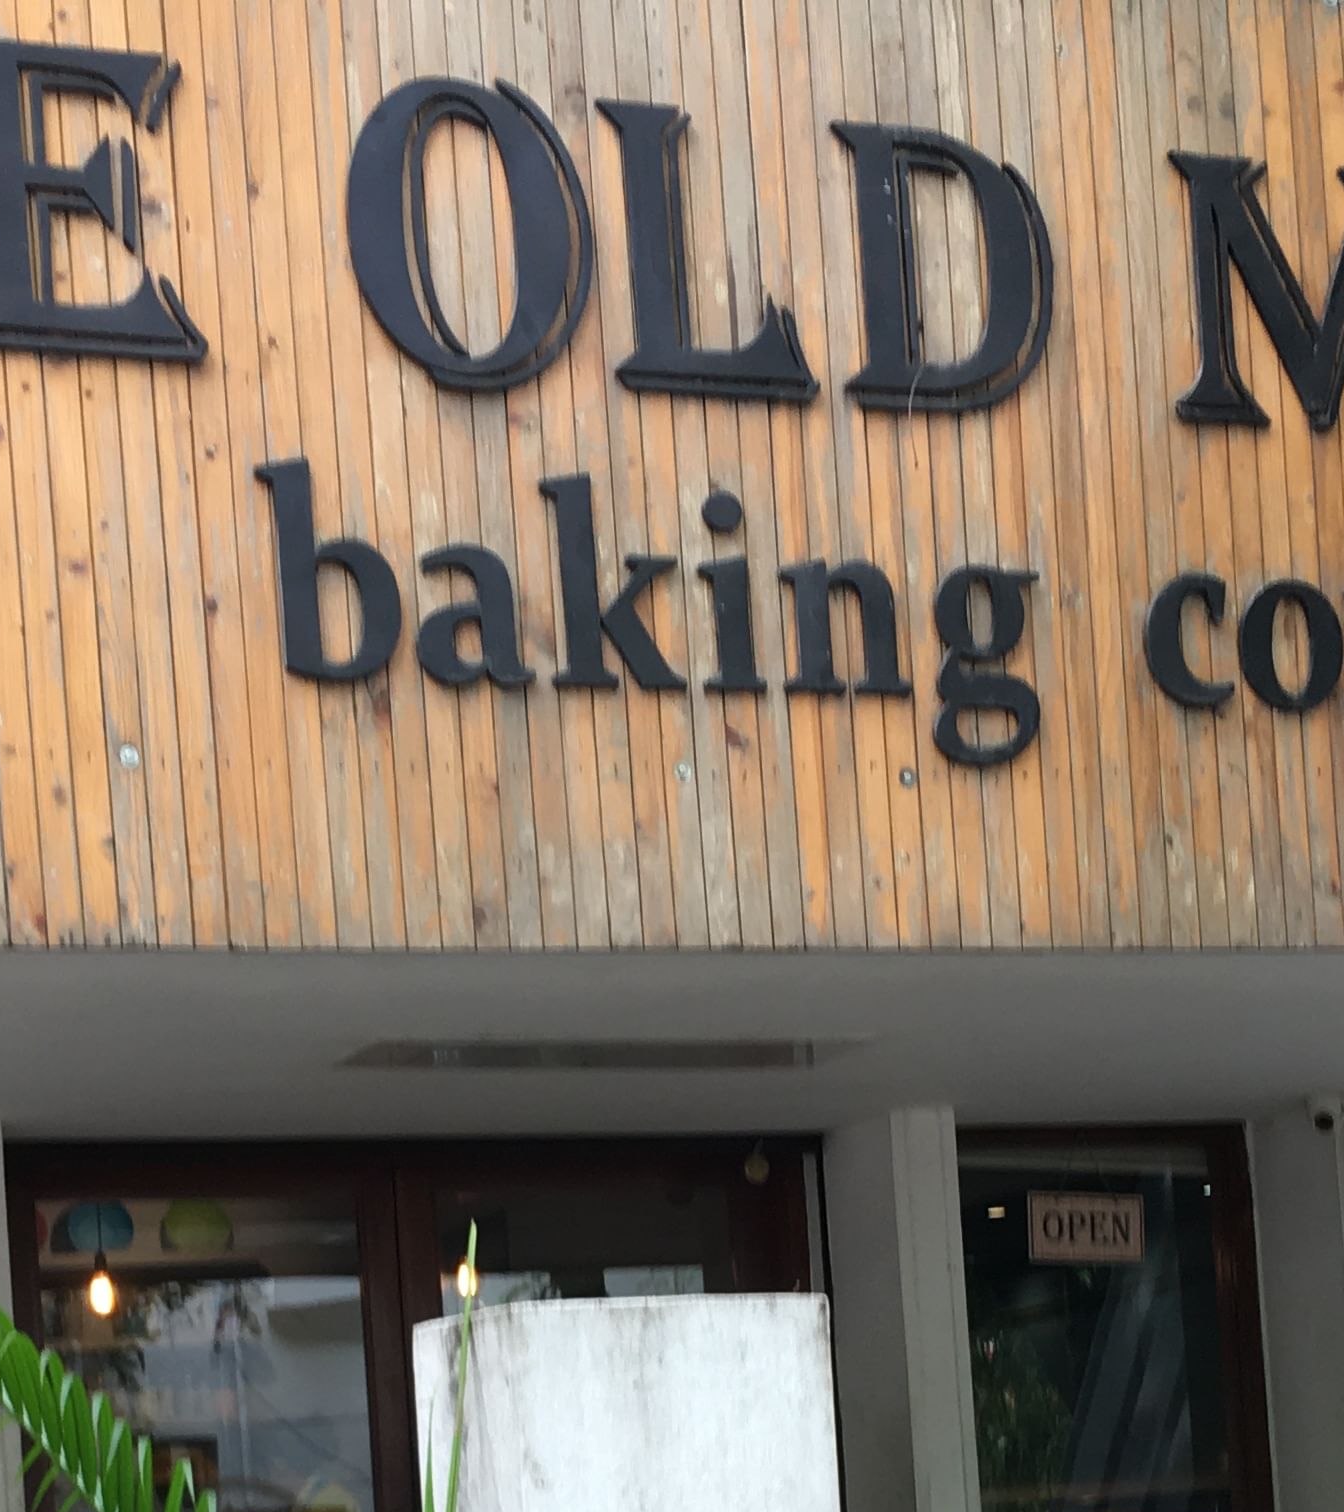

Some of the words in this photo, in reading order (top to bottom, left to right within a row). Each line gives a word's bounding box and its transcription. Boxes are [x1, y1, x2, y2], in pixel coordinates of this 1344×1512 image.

[347, 77, 1055, 414] OLD
[256, 458, 1039, 768] baking
[1042, 1210, 1131, 1245] OPEN
